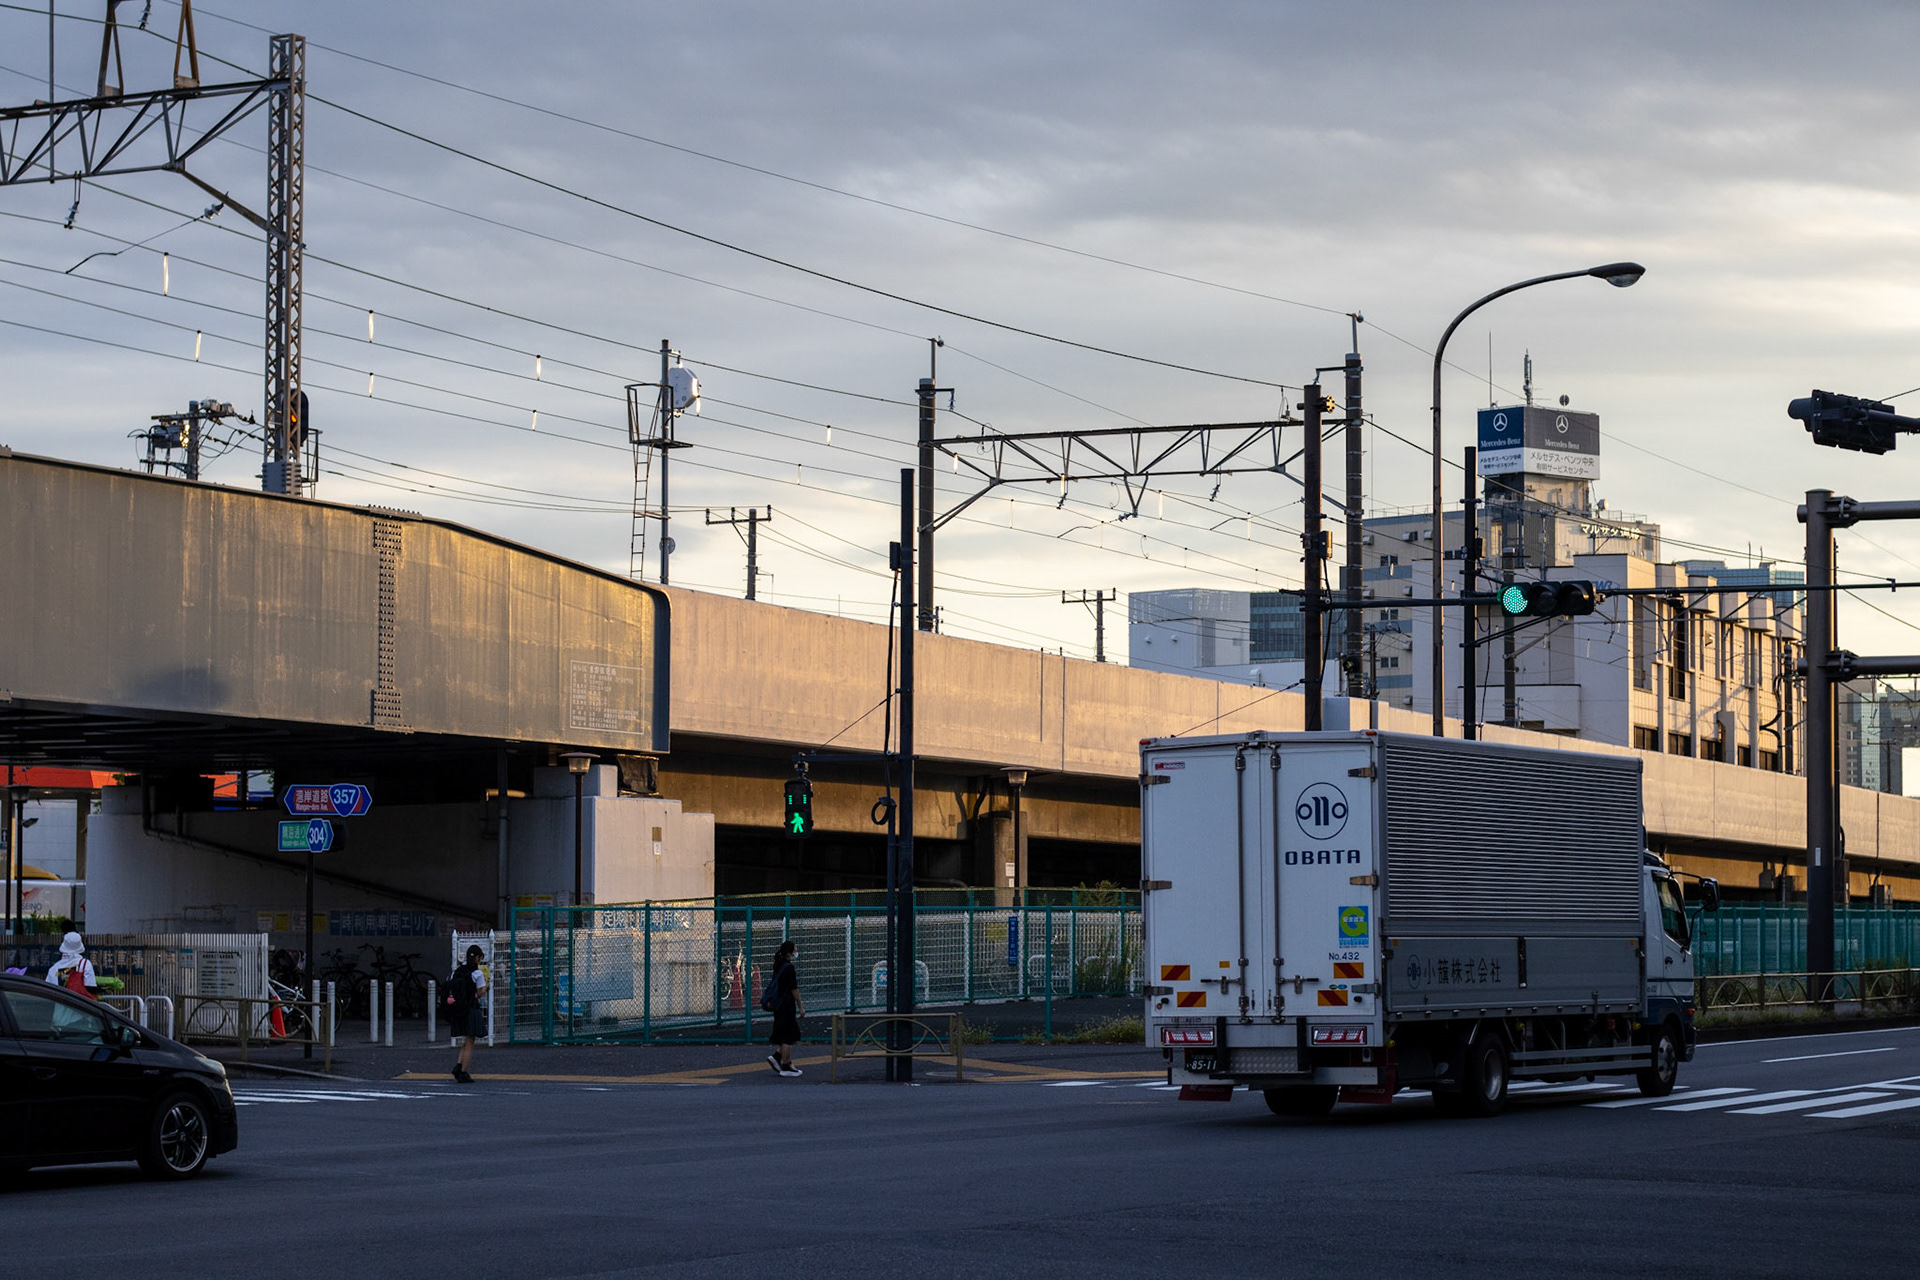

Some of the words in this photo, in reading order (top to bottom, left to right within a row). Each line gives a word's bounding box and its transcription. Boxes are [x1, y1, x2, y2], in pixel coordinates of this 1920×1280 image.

[1531, 452, 1595, 467] メルセデス・ベンツ中央
[1537, 463, 1589, 475] 有明サービスセンター
[296, 789, 329, 803] 湾岸道路
[333, 789, 356, 804] 357
[309, 827, 325, 844] 304
[1285, 850, 1360, 865] OBATA
[330, 913, 435, 931] 一時利用専用エリア
[1328, 952, 1360, 961] No.432
